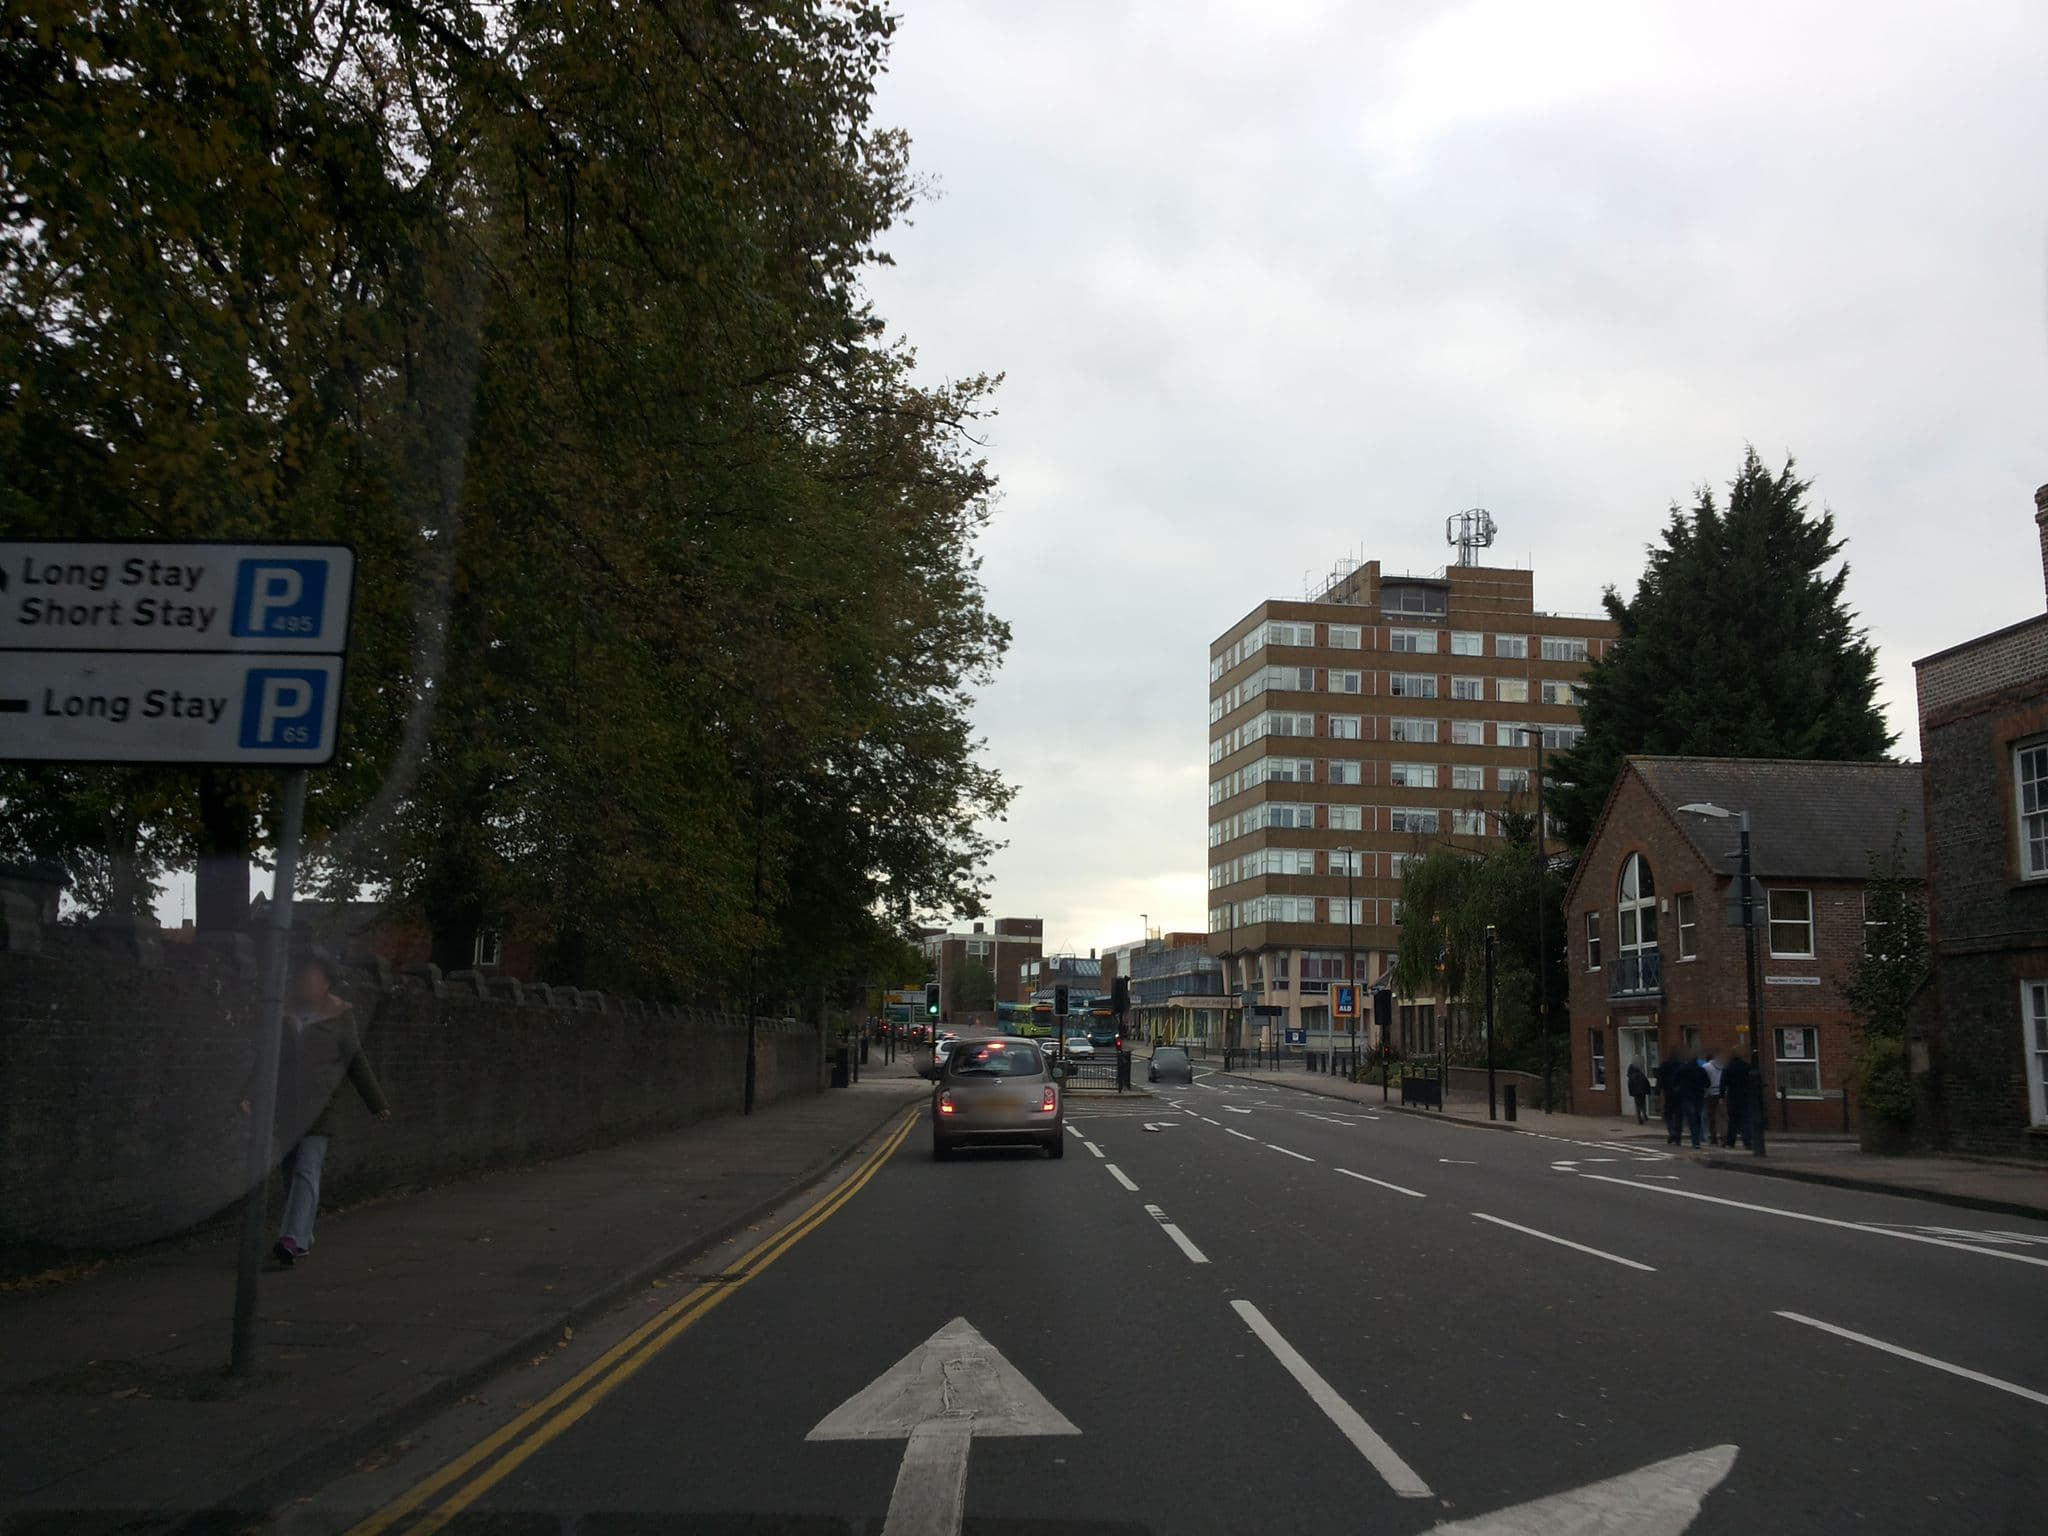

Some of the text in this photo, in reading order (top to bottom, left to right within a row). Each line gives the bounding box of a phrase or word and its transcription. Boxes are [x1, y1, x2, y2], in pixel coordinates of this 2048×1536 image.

[22, 557, 205, 592] Long Stay
[18, 598, 218, 633] Short Stay
[248, 567, 304, 631] P
[272, 616, 313, 632] 495
[43, 688, 229, 724] Long Stay
[258, 677, 314, 743] P
[283, 727, 310, 742] 65
